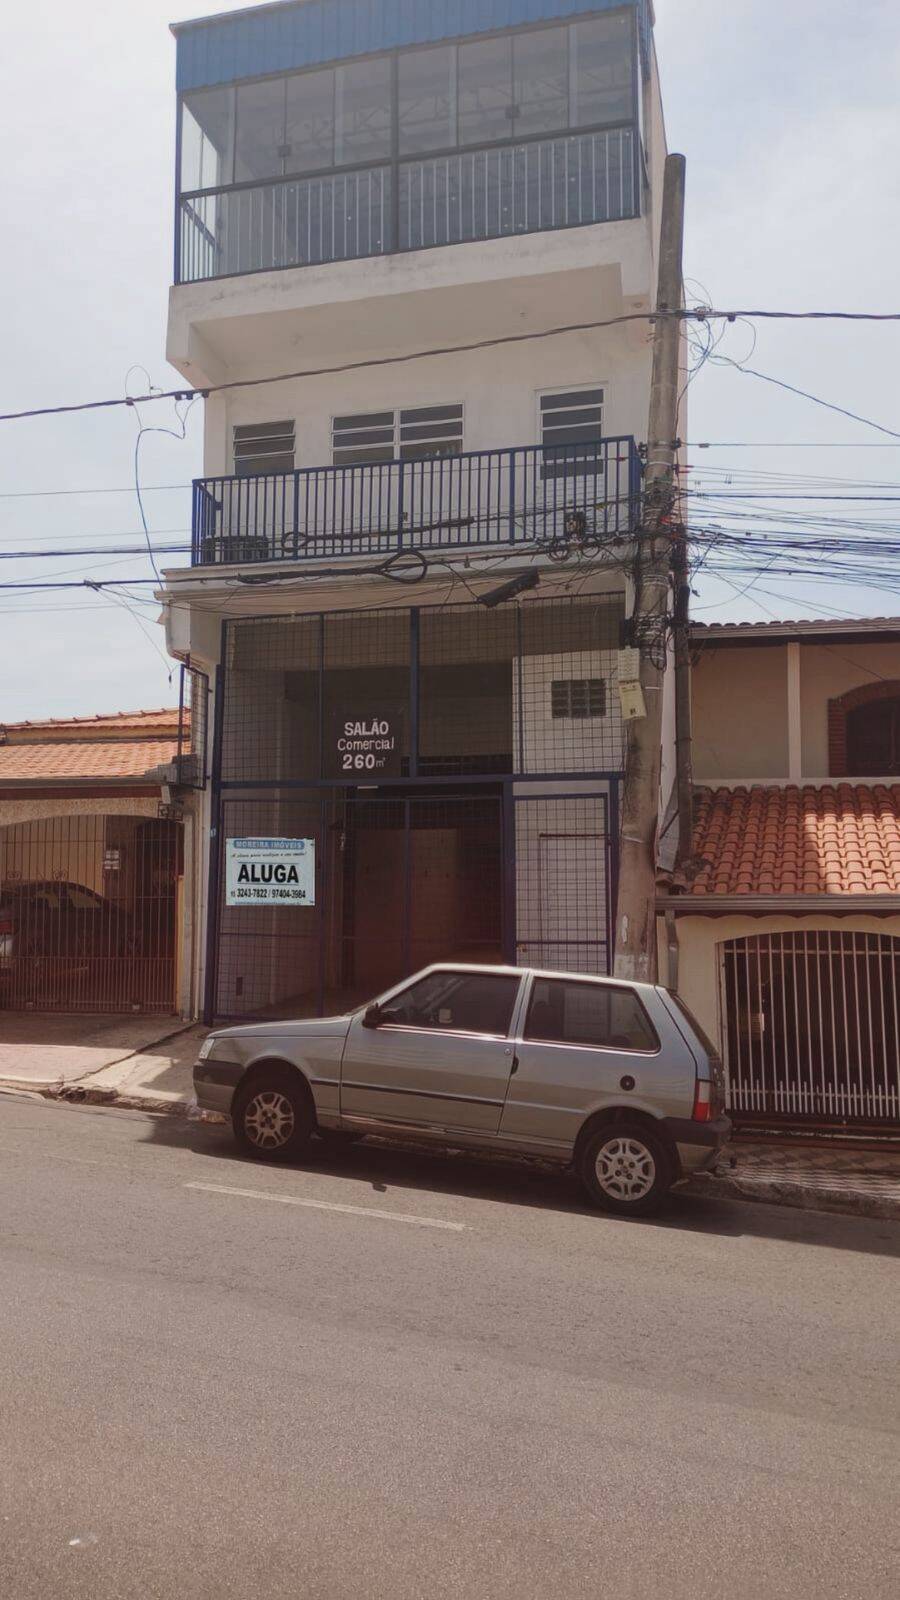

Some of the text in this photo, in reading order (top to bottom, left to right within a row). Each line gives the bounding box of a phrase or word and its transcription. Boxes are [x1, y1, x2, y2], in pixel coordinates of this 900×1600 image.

[344, 717, 389, 736] SALÃO
[337, 736, 395, 751] Comercial
[237, 864, 299, 883] ALUGA
[237, 889, 268, 898] 3243-7822
